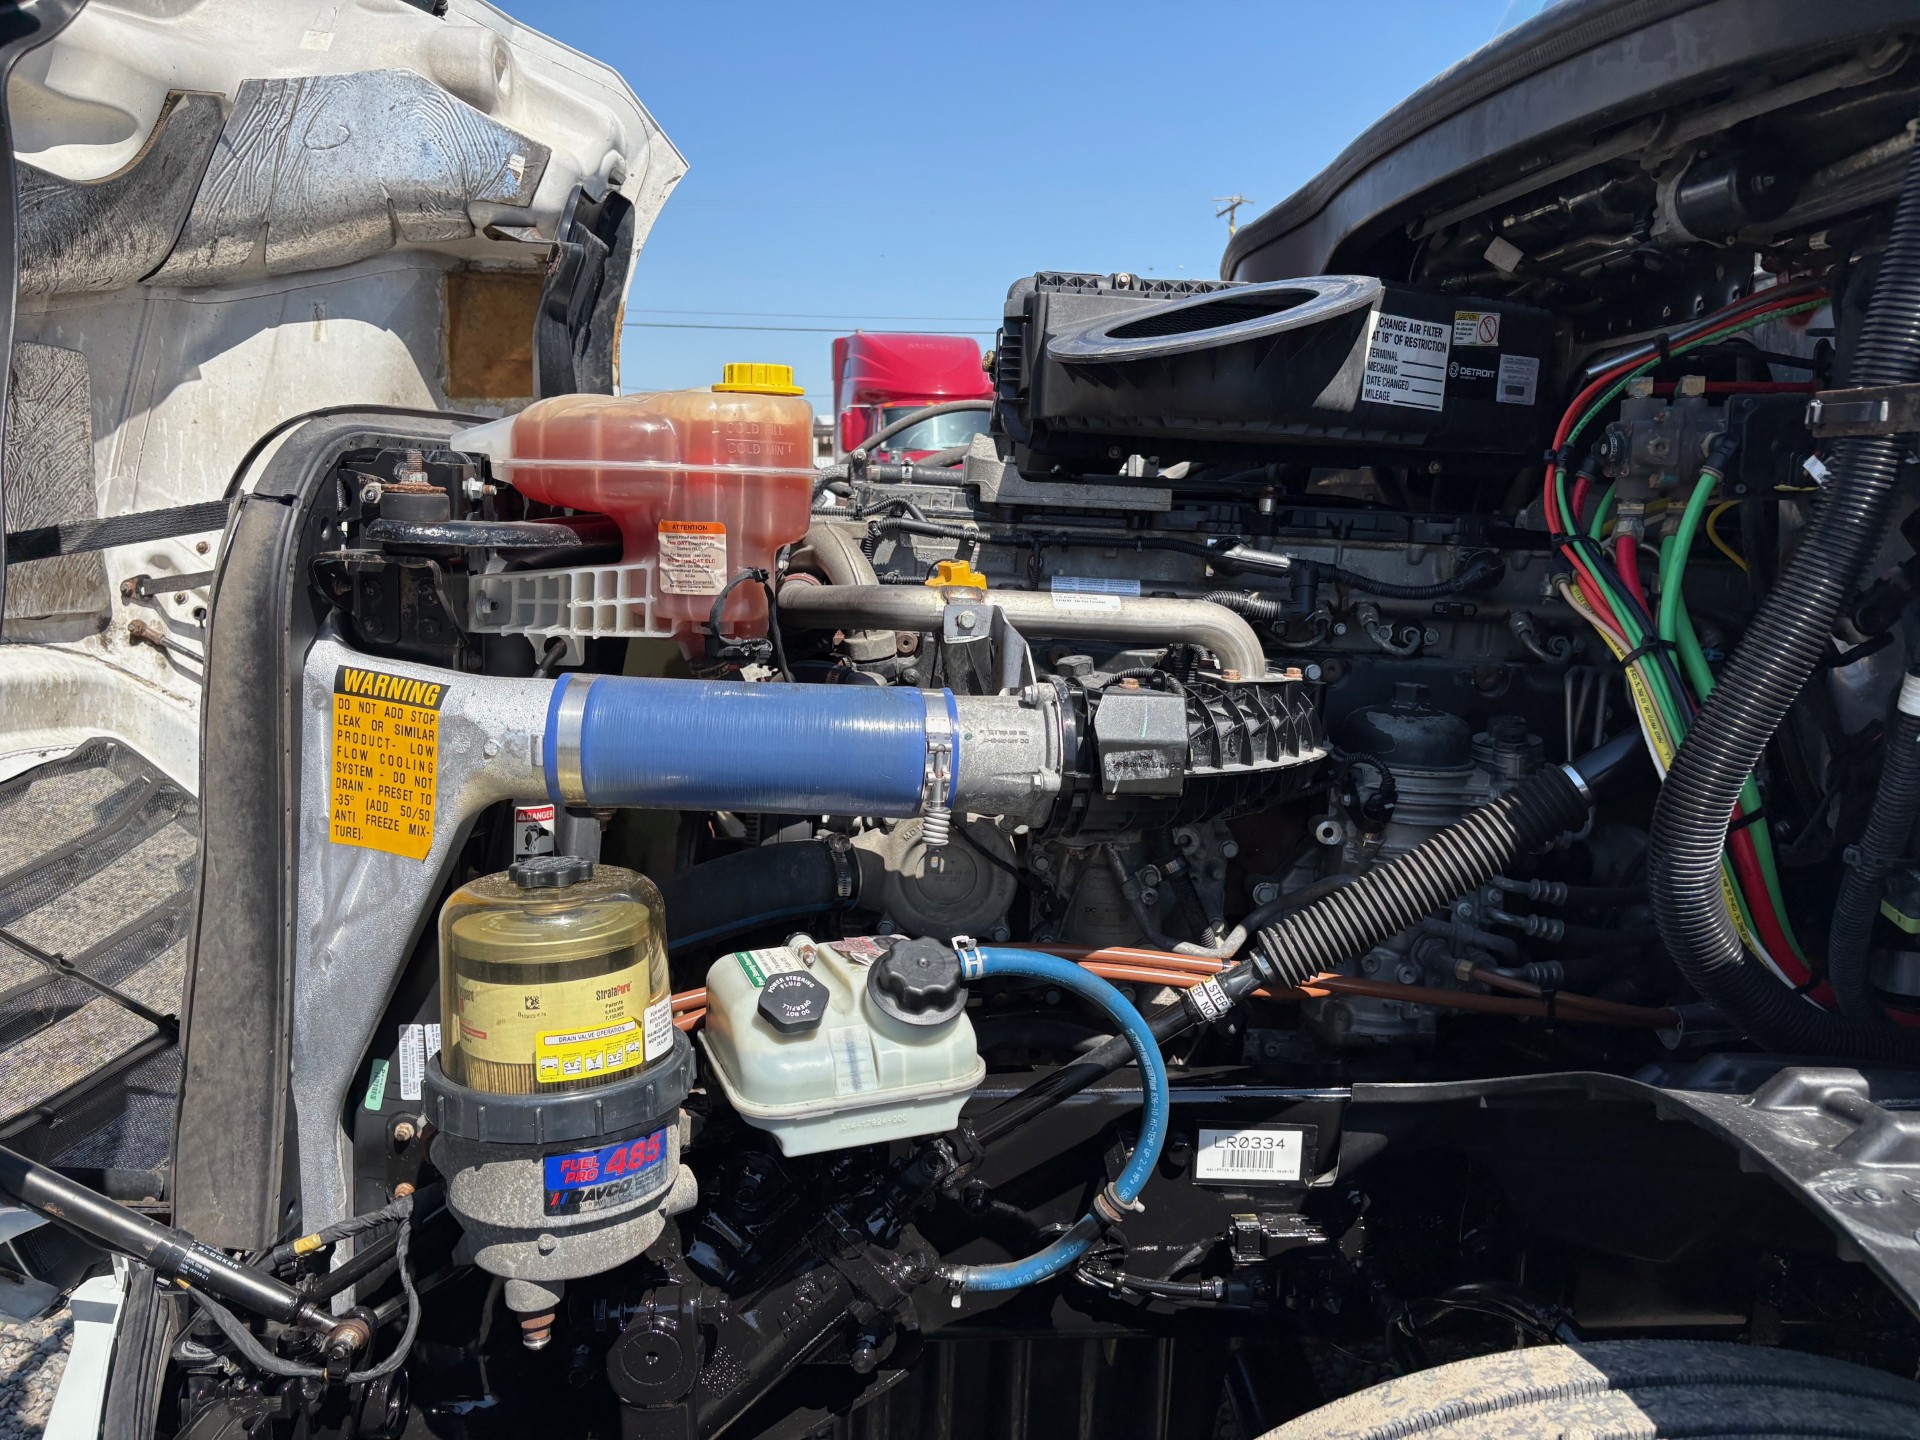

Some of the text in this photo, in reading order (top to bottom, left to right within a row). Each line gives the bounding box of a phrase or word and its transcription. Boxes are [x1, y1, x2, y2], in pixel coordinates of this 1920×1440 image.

[1380, 317, 1407, 332] CHANGE
[1409, 322, 1421, 335] AIR
[1423, 324, 1443, 338] FILTER
[1372, 331, 1380, 341] AT
[1394, 334, 1403, 345] OF
[1405, 336, 1447, 353] RESTRICTION
[1369, 347, 1398, 361] TERMINAL
[1367, 361, 1398, 375] MECHANIC
[1460, 367, 1495, 378] DETROIT
[1366, 375, 1410, 390] DATE CHANGED
[1365, 388, 1390, 401] MILEAGE
[727, 442, 760, 454] COLD
[344, 668, 440, 706] WARNING
[338, 698, 435, 725] DO NOT ADD STOP
[338, 714, 434, 742] LEAK OR SIMILAR
[410, 743, 434, 757] LOW
[337, 746, 433, 774] FLOW COOLING
[337, 762, 373, 778] SYSTEM
[394, 772, 406, 784] DO
[415, 776, 432, 790] NOT
[336, 778, 363, 792] DRAIN
[378, 785, 413, 802] PRESET
[421, 793, 432, 805] TO
[335, 794, 354, 806] -35°
[400, 805, 430, 822] 50/50
[526, 810, 553, 820] DANGER
[335, 809, 430, 837] ANTI FREEZE MIX-
[596, 983, 631, 1000] StrataPore
[768, 976, 815, 993] POWER STEERING
[780, 981, 801, 989] FLUID
[1208, 984, 1228, 1007] STEP
[782, 1000, 811, 1011] OVERFILL
[1201, 1001, 1214, 1016] NO
[596, 1026, 625, 1037] OPERATION
[1151, 1093, 1159, 1116] 836-10
[1214, 1135, 1285, 1150] LR0334
[560, 1133, 662, 1176] FUEL 485
[1137, 1159, 1147, 1171] 2.4
[564, 1168, 599, 1184] PRO
[1130, 1173, 1140, 1185] MPa
[568, 1178, 633, 1204] DAVCO
[198, 1246, 239, 1269] BLOCKER
